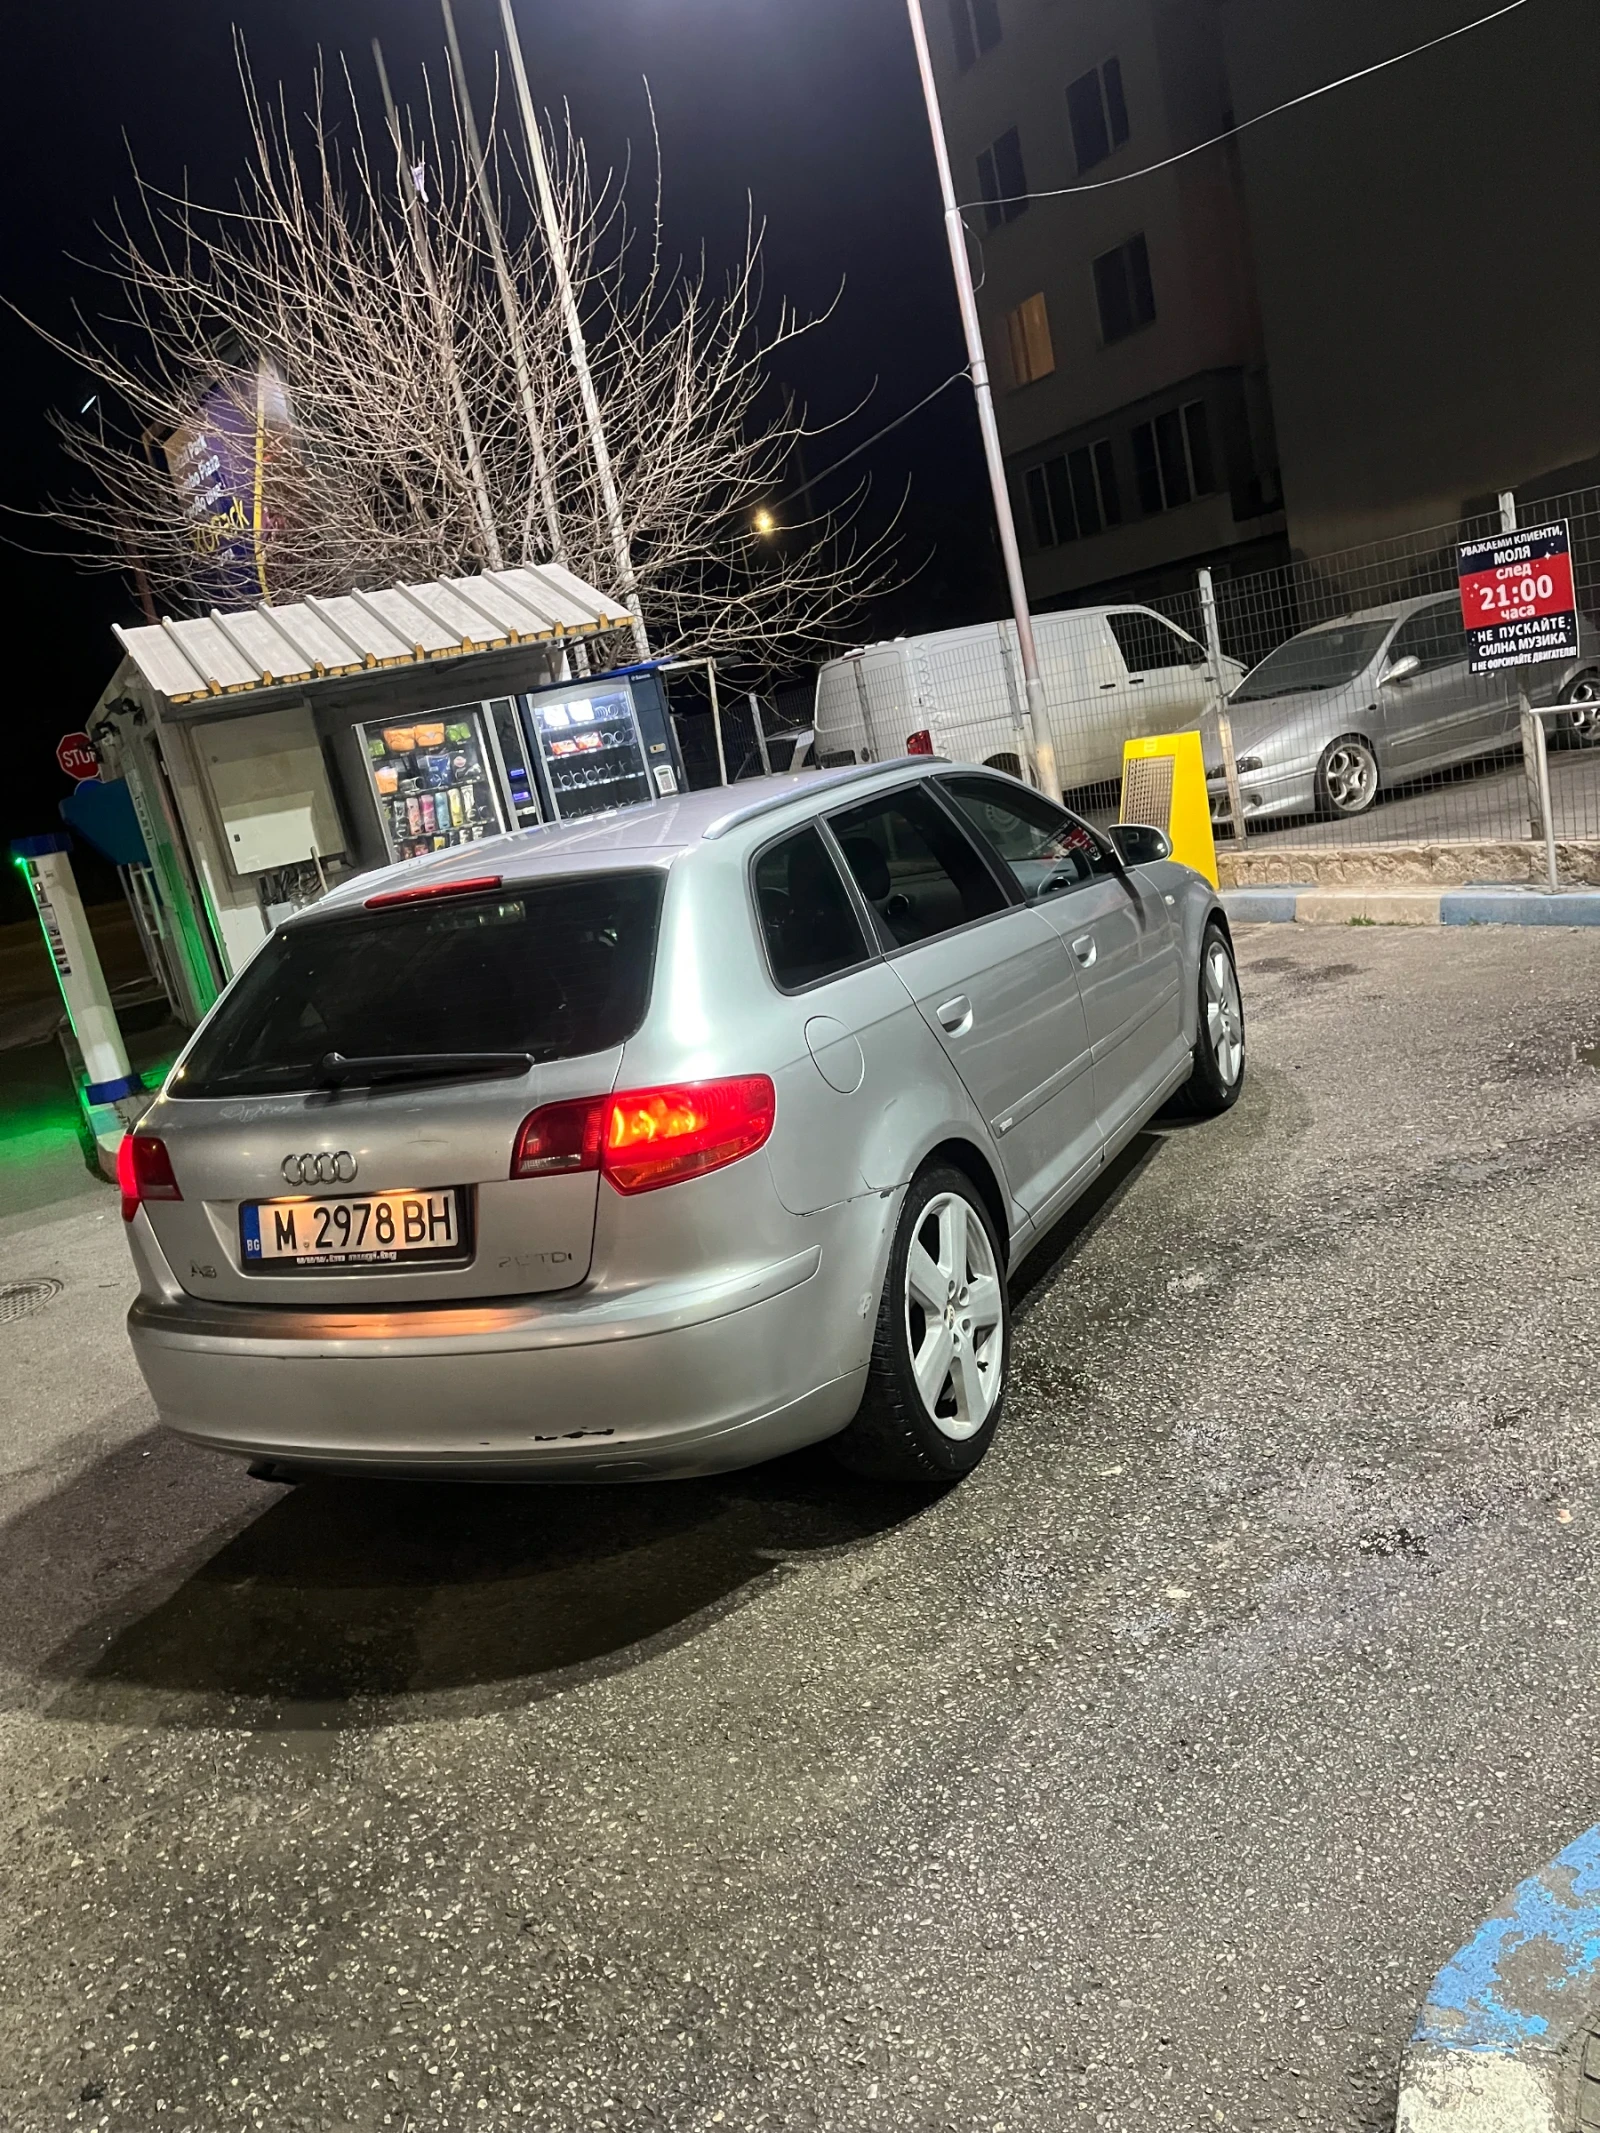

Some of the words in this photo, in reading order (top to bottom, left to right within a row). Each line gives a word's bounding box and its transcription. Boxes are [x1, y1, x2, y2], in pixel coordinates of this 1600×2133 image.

[1460, 537, 1512, 557] УВАЖАЕМИ
[1514, 525, 1563, 545] КЛИЕНТИ,
[1493, 545, 1531, 565] МОЛЯ
[1496, 563, 1532, 580] след
[1480, 574, 1553, 611] 21:00
[1501, 604, 1536, 620] часа
[1477, 630, 1493, 642] НЕ
[1499, 616, 1566, 639] ПУСКАЙТЕ
[1479, 640, 1517, 657] СИЛНА
[1518, 632, 1567, 650] МУЗИКА
[1471, 662, 1478, 672] И
[1478, 660, 1487, 671] НЕ
[313, 1202, 396, 1249] 2978
[246, 1238, 260, 1252] BG
